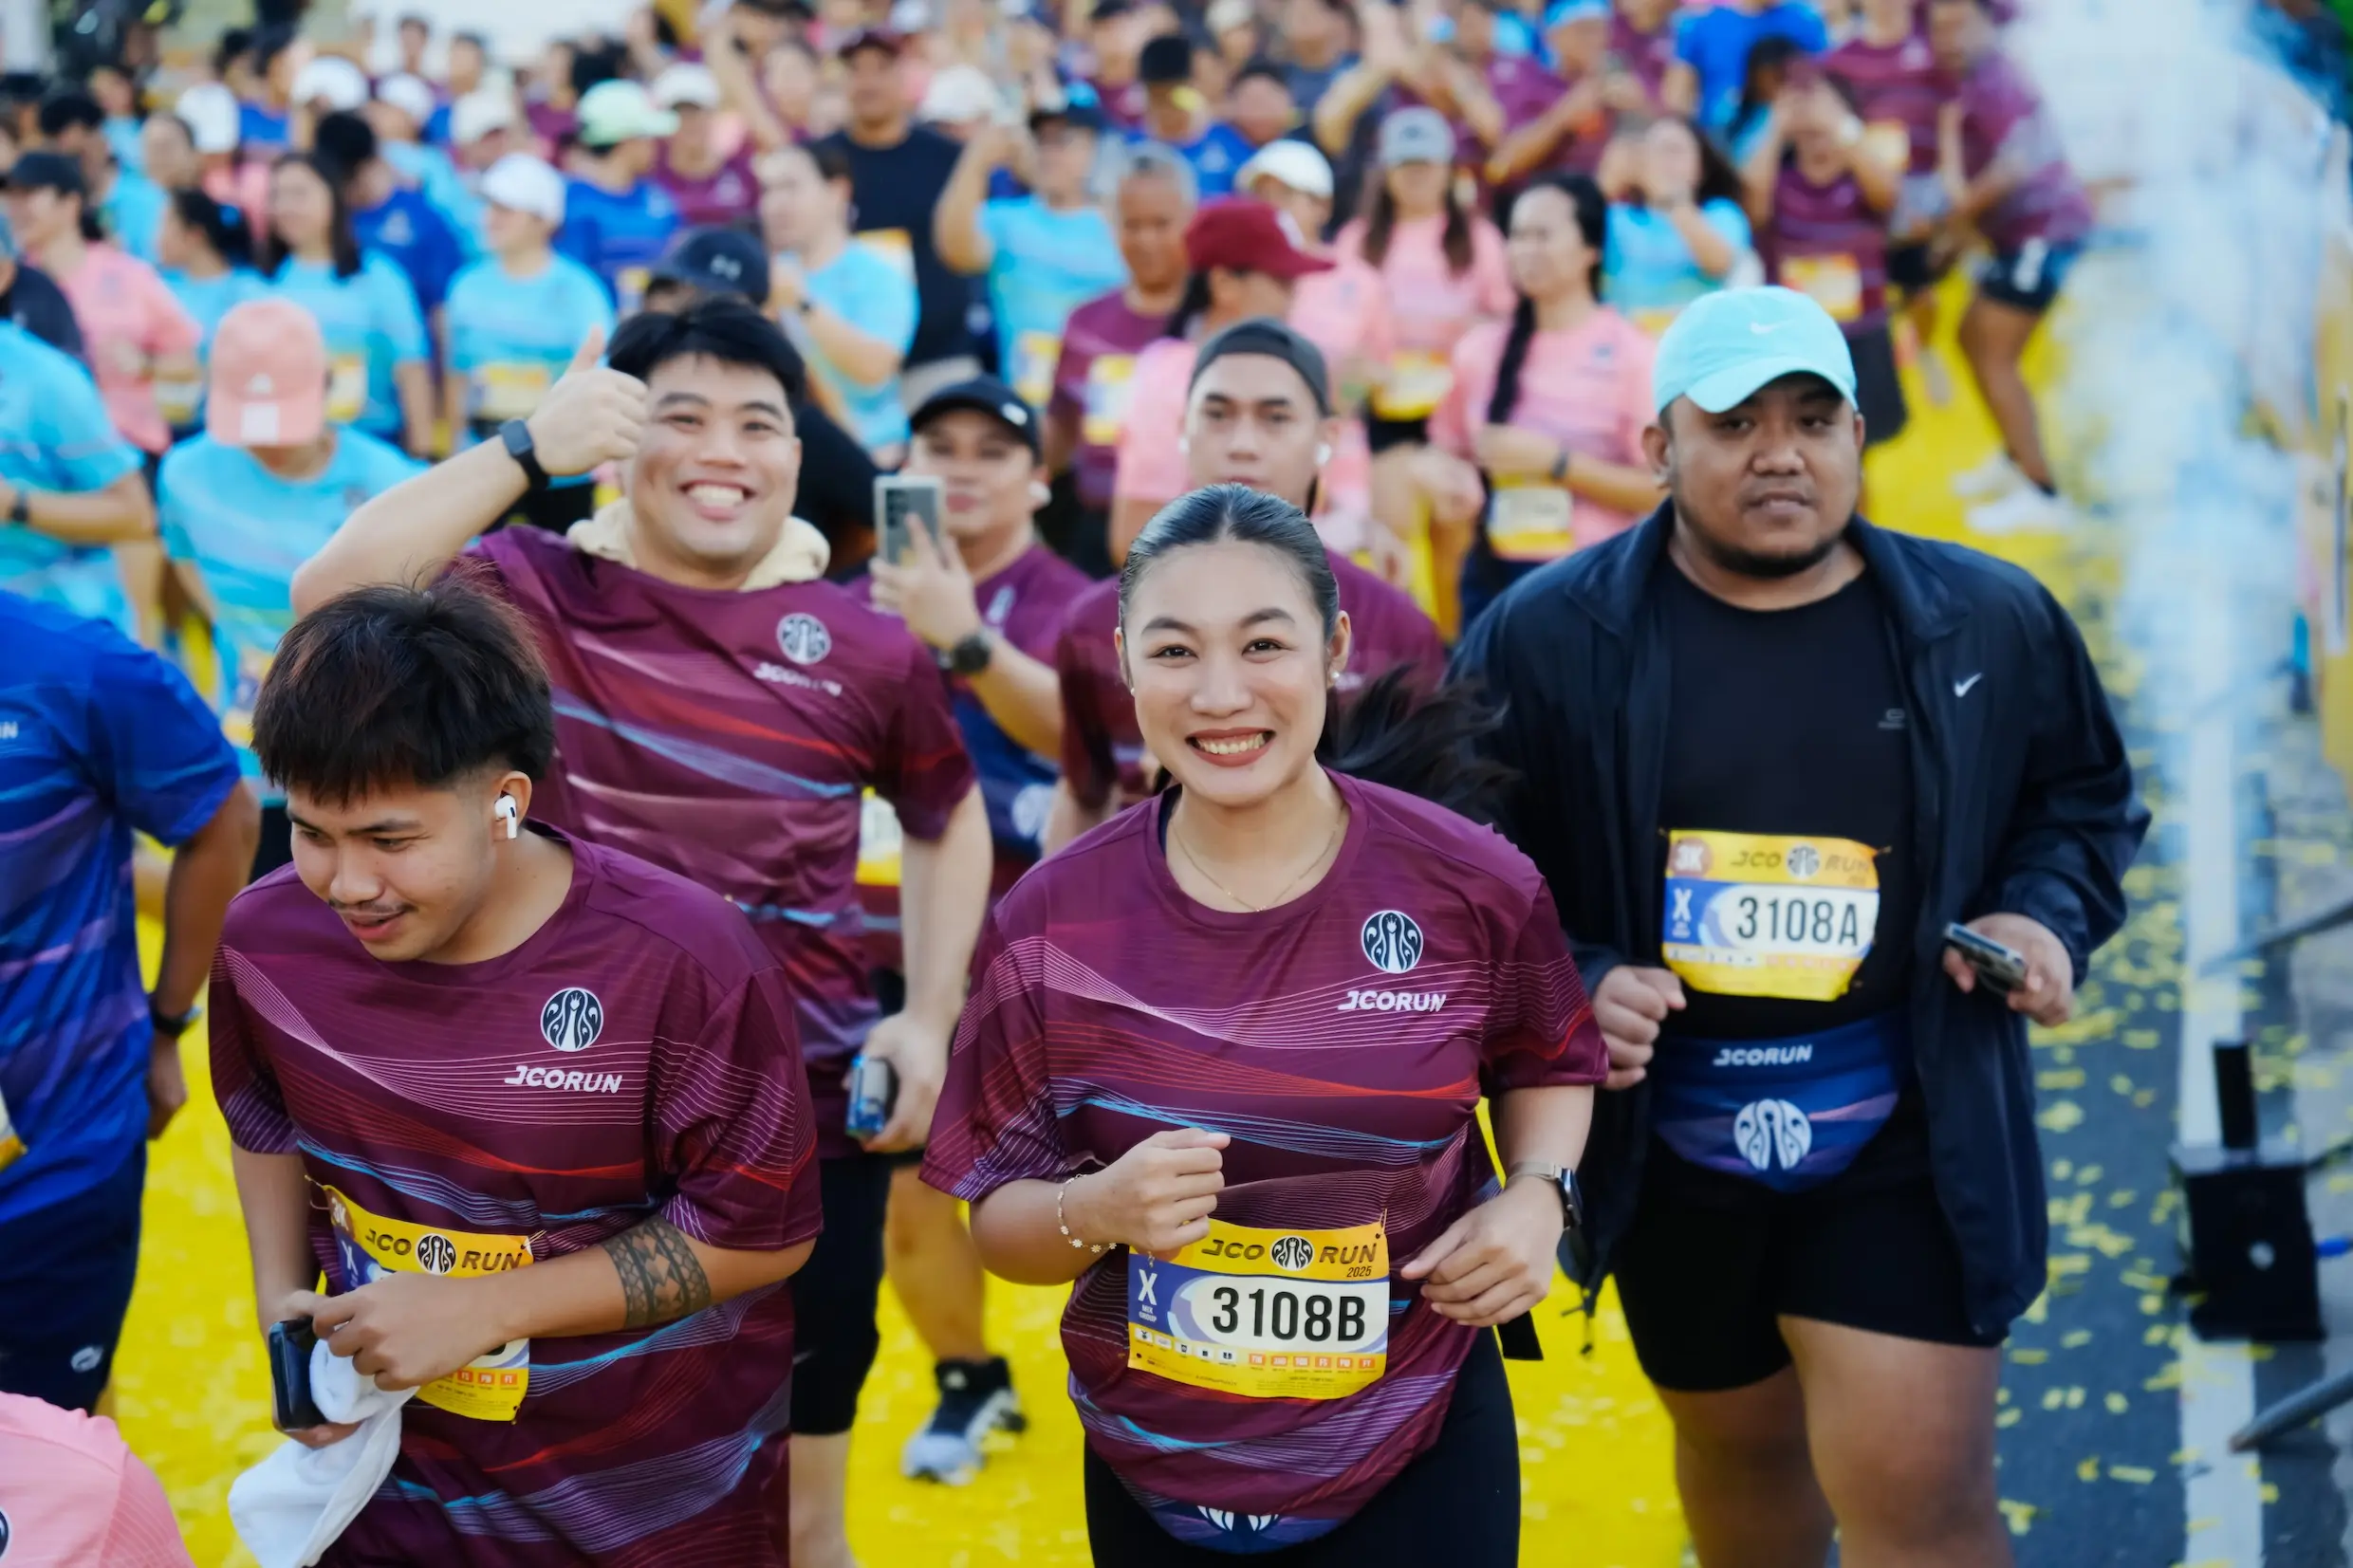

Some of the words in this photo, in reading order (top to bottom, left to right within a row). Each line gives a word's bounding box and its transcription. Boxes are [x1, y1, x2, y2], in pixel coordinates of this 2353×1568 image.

[1676, 842, 1704, 872] 3K
[1731, 850, 1782, 869] JCO
[1825, 854, 1871, 873] RUN
[1673, 887, 1694, 922] X
[1737, 896, 1859, 947] 3108A
[1338, 990, 1447, 1012] JCORUN
[1713, 1044, 1812, 1066] JCORUN
[504, 1065, 622, 1094] JCORUN
[342, 1239, 359, 1277] X
[364, 1227, 412, 1256] JCO
[462, 1250, 523, 1272] RUN
[1201, 1239, 1266, 1261] JCO
[1319, 1243, 1377, 1264] RUN
[1139, 1268, 1158, 1305] X
[1346, 1265, 1372, 1278] 2025
[1213, 1286, 1365, 1342] 3108B
